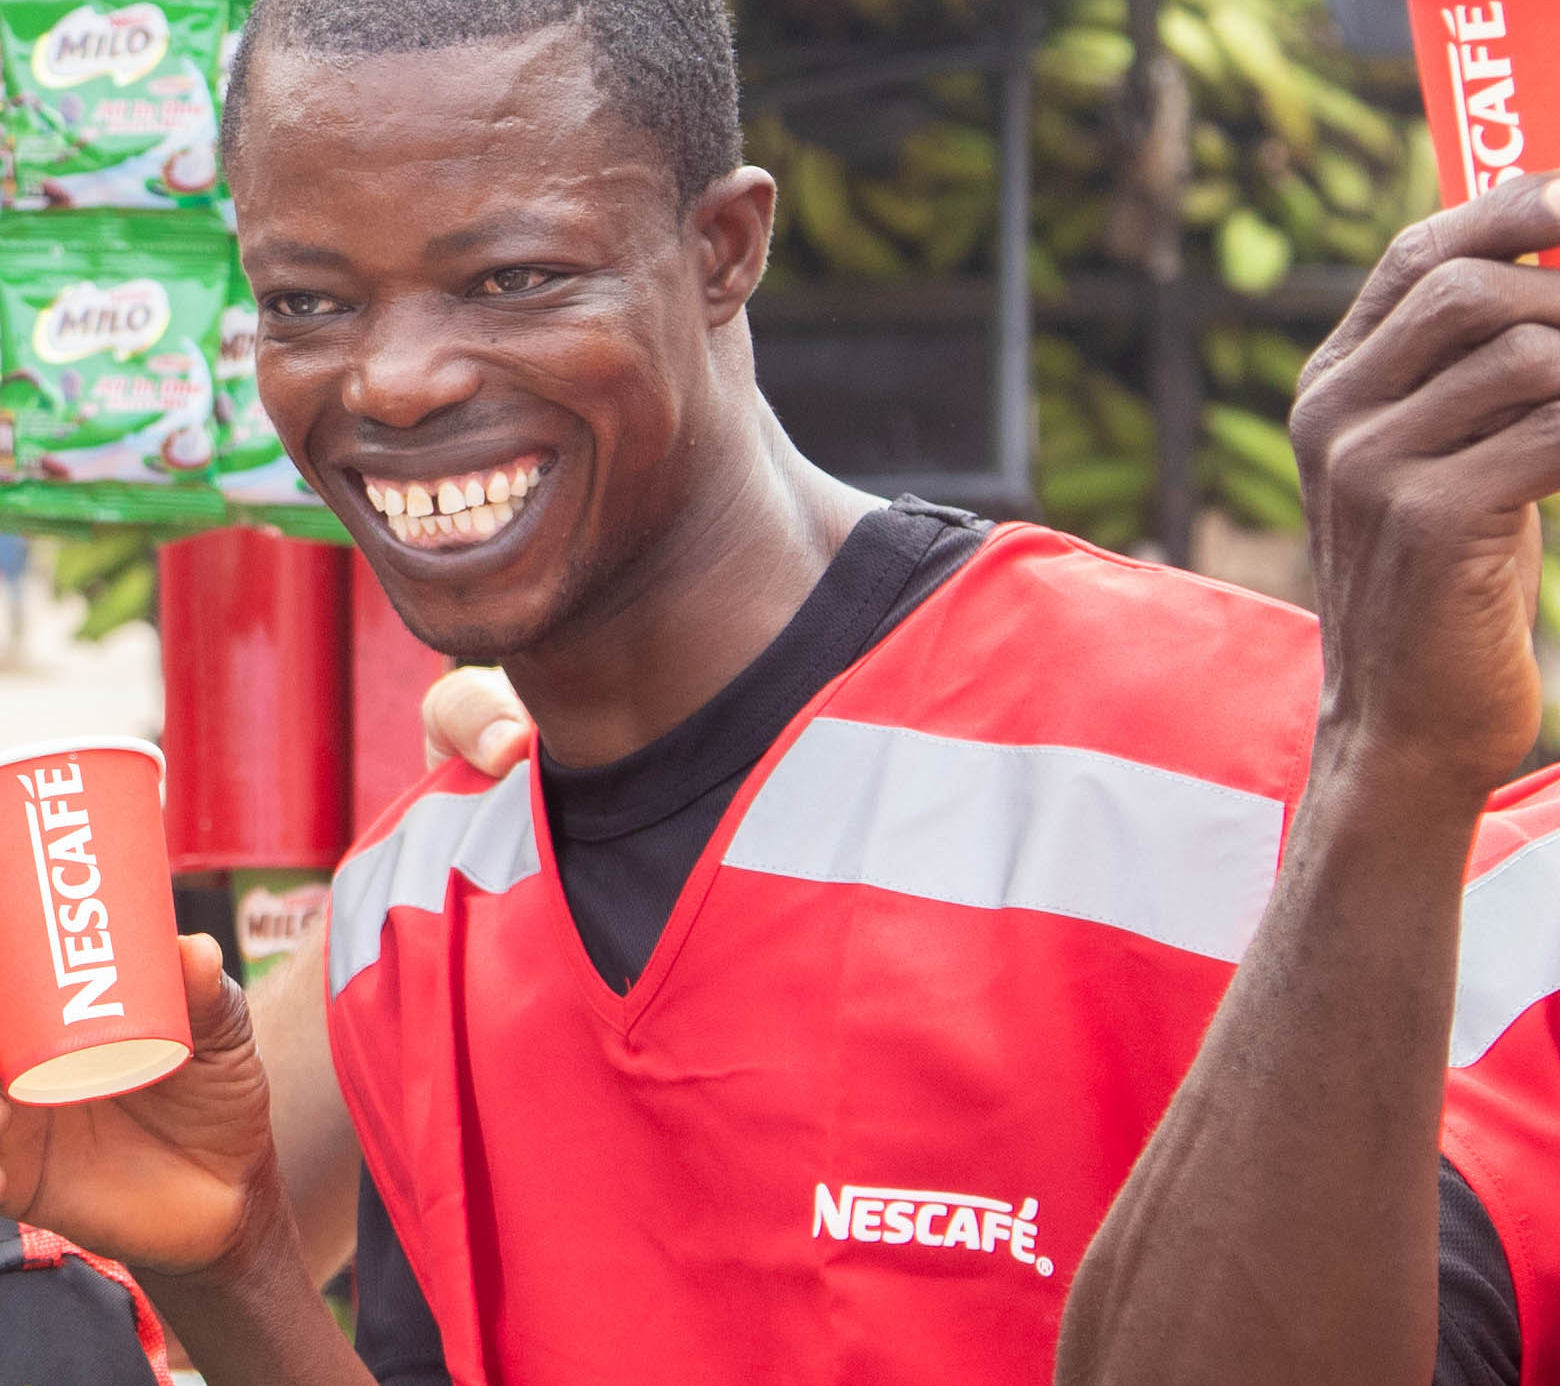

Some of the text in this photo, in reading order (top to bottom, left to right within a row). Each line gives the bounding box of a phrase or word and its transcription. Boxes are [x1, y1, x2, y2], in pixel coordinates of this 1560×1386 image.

[57, 29, 151, 61] MILO
[1441, 0, 1525, 203] SCAFÉ
[57, 304, 151, 337] MILO
[18, 762, 125, 1026] NESCAFÉ
[812, 1182, 1040, 1265] NESCAFÉ
